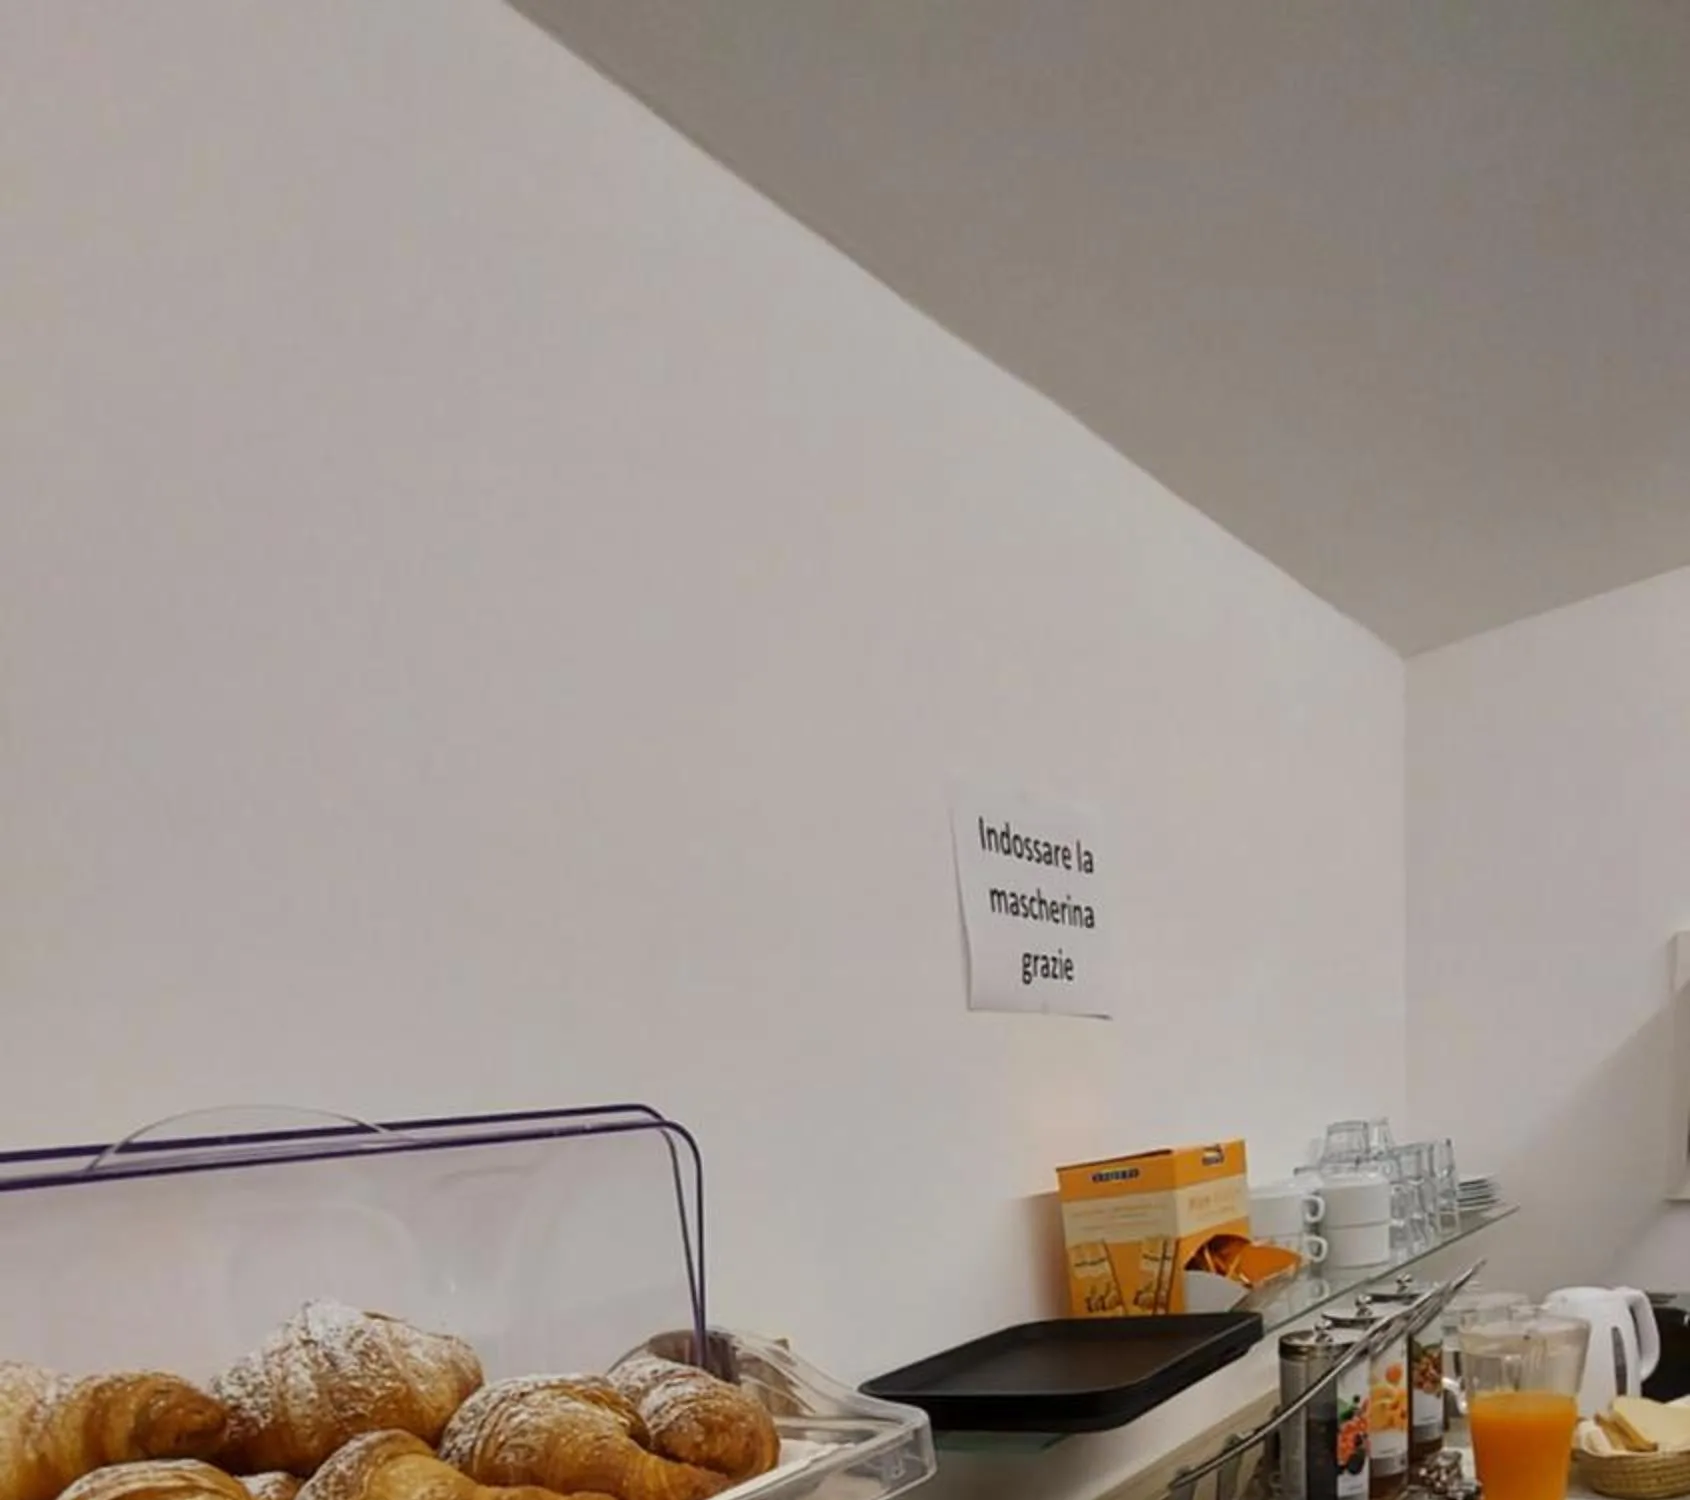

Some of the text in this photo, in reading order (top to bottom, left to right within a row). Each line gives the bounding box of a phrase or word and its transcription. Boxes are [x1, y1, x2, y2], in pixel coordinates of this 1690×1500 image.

[978, 815, 1094, 874] Indossare la
[989, 887, 1095, 928] mascherina
[1022, 948, 1075, 985] grazie
